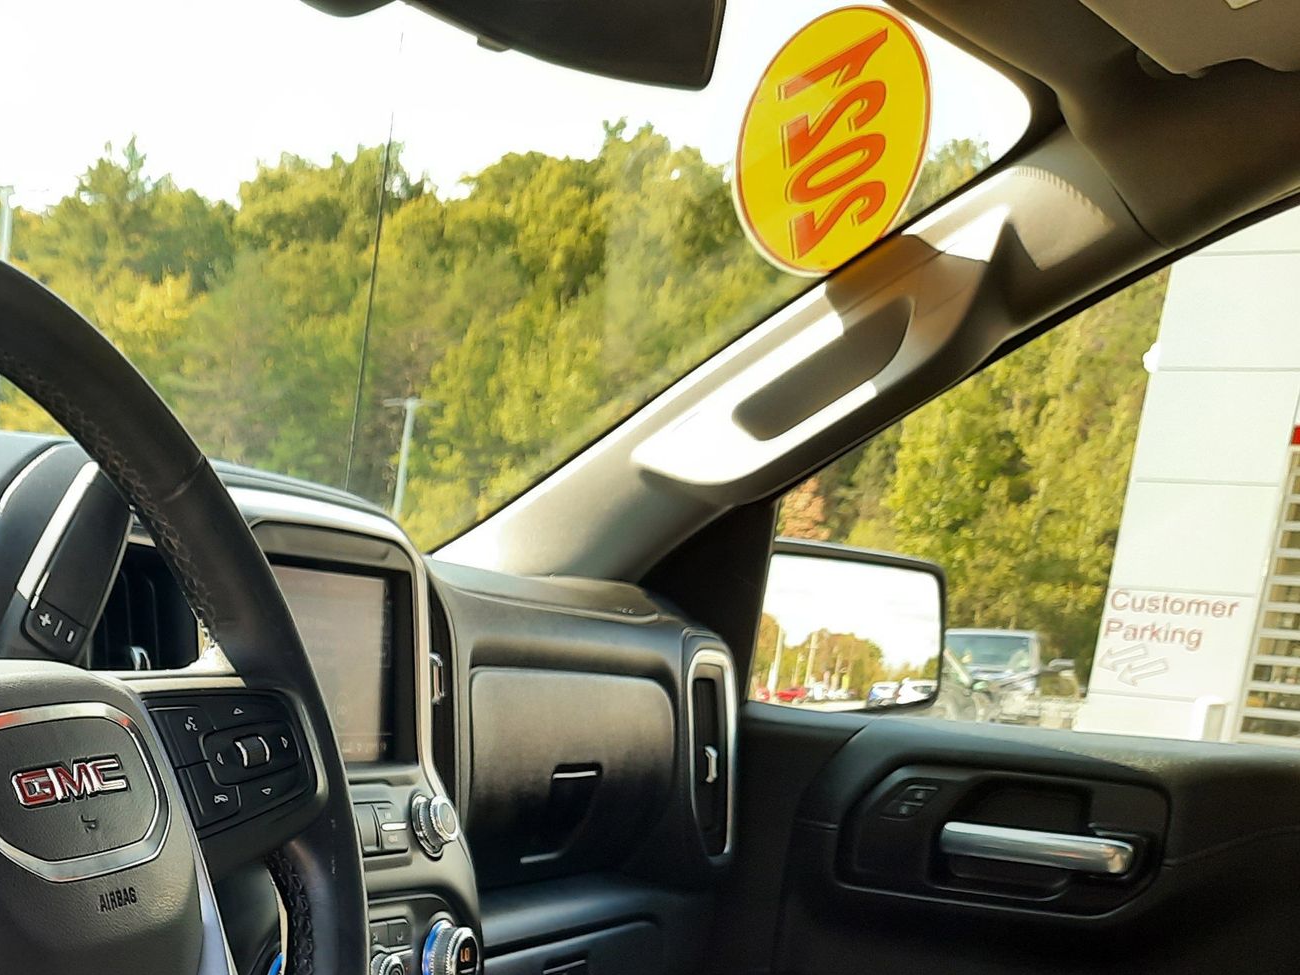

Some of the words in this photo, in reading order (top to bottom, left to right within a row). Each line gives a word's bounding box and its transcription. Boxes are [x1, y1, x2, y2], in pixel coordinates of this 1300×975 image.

[1110, 588, 1241, 618] Customer
[1104, 618, 1204, 652] Parking
[11, 758, 128, 806] GMC
[99, 887, 137, 912] AIRBAG
